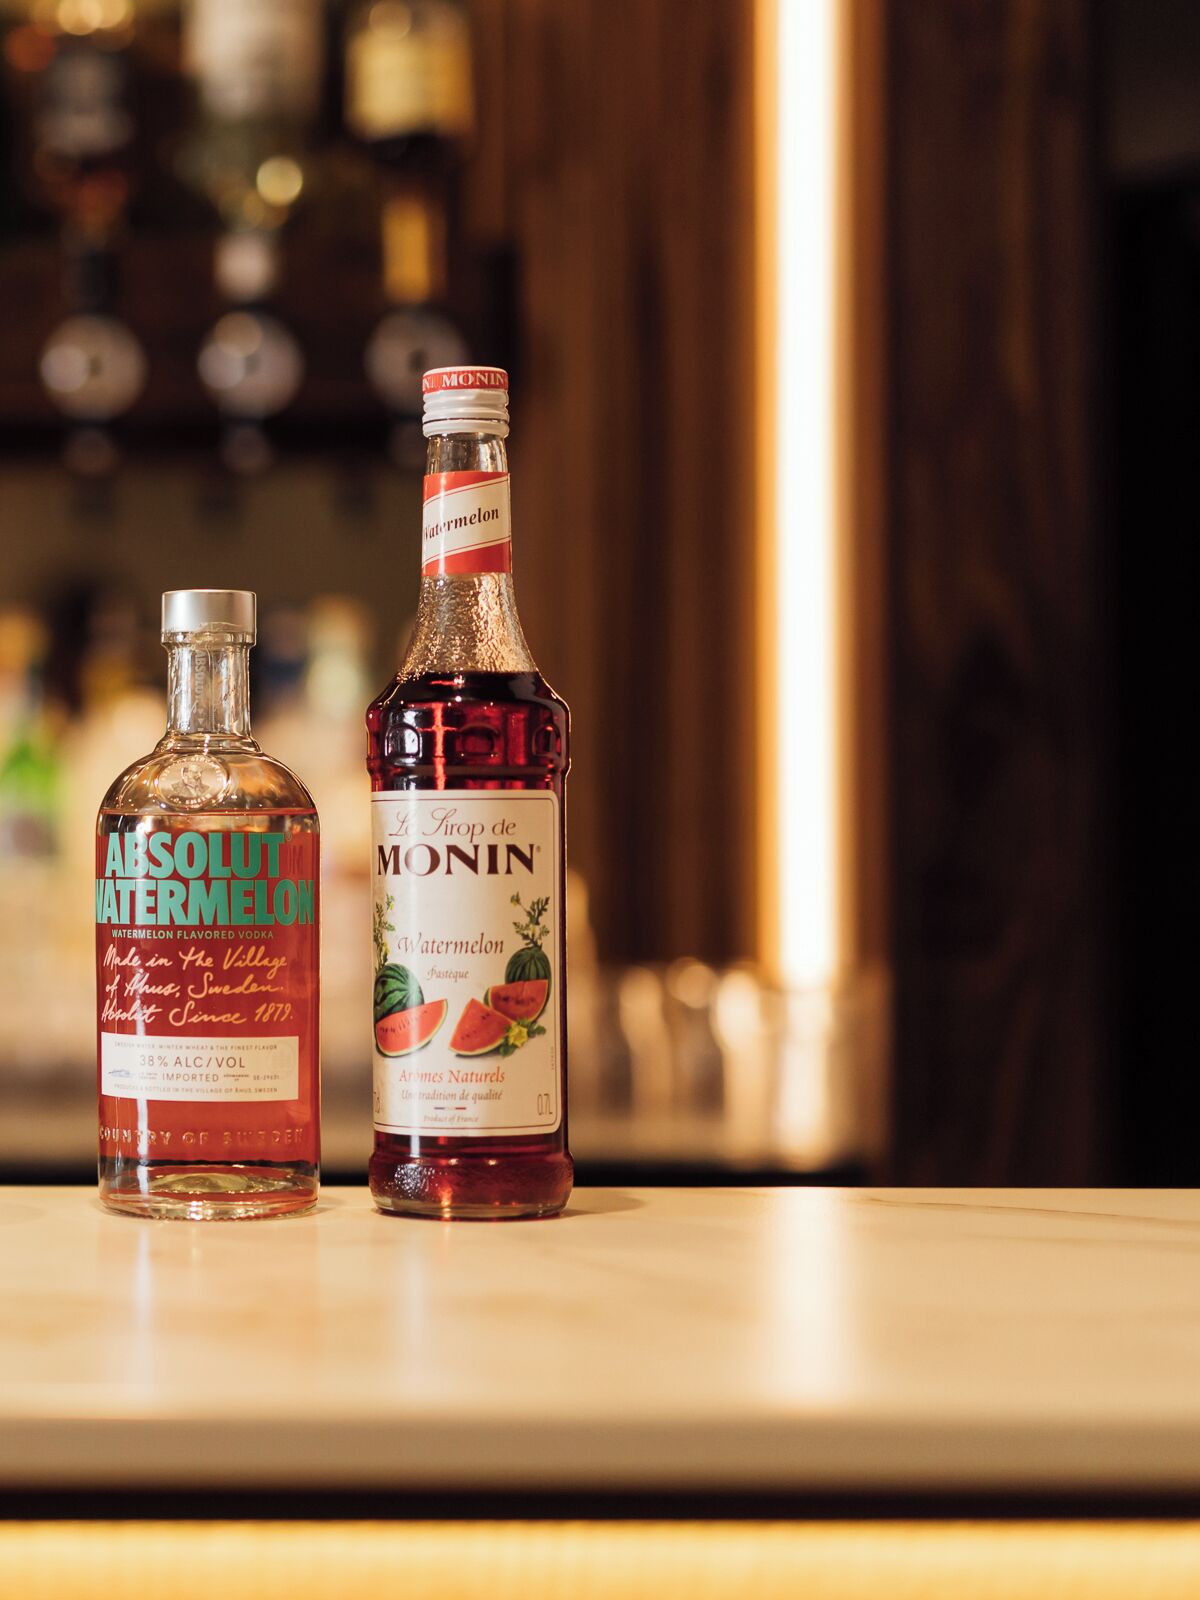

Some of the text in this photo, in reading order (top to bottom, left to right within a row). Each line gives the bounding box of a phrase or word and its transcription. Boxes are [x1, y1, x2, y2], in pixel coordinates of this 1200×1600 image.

[442, 372, 505, 387] MONIN
[422, 808, 485, 843] Sirop
[491, 819, 517, 836] de
[104, 832, 284, 879] ABSOLUT
[112, 929, 274, 940] WATERMELON FLAVORED VODKA
[397, 932, 504, 955] Watermelon
[103, 943, 287, 980] Made in the Village
[105, 974, 119, 999] of
[187, 972, 284, 999] Sweden.
[101, 998, 294, 1026] Absolut Since 1879.
[140, 1055, 245, 1069] 38% ALC/VOL
[163, 1072, 219, 1082] IMPORTED
[399, 1066, 505, 1083] Armes Naturels
[182, 1132, 208, 1144] OF
